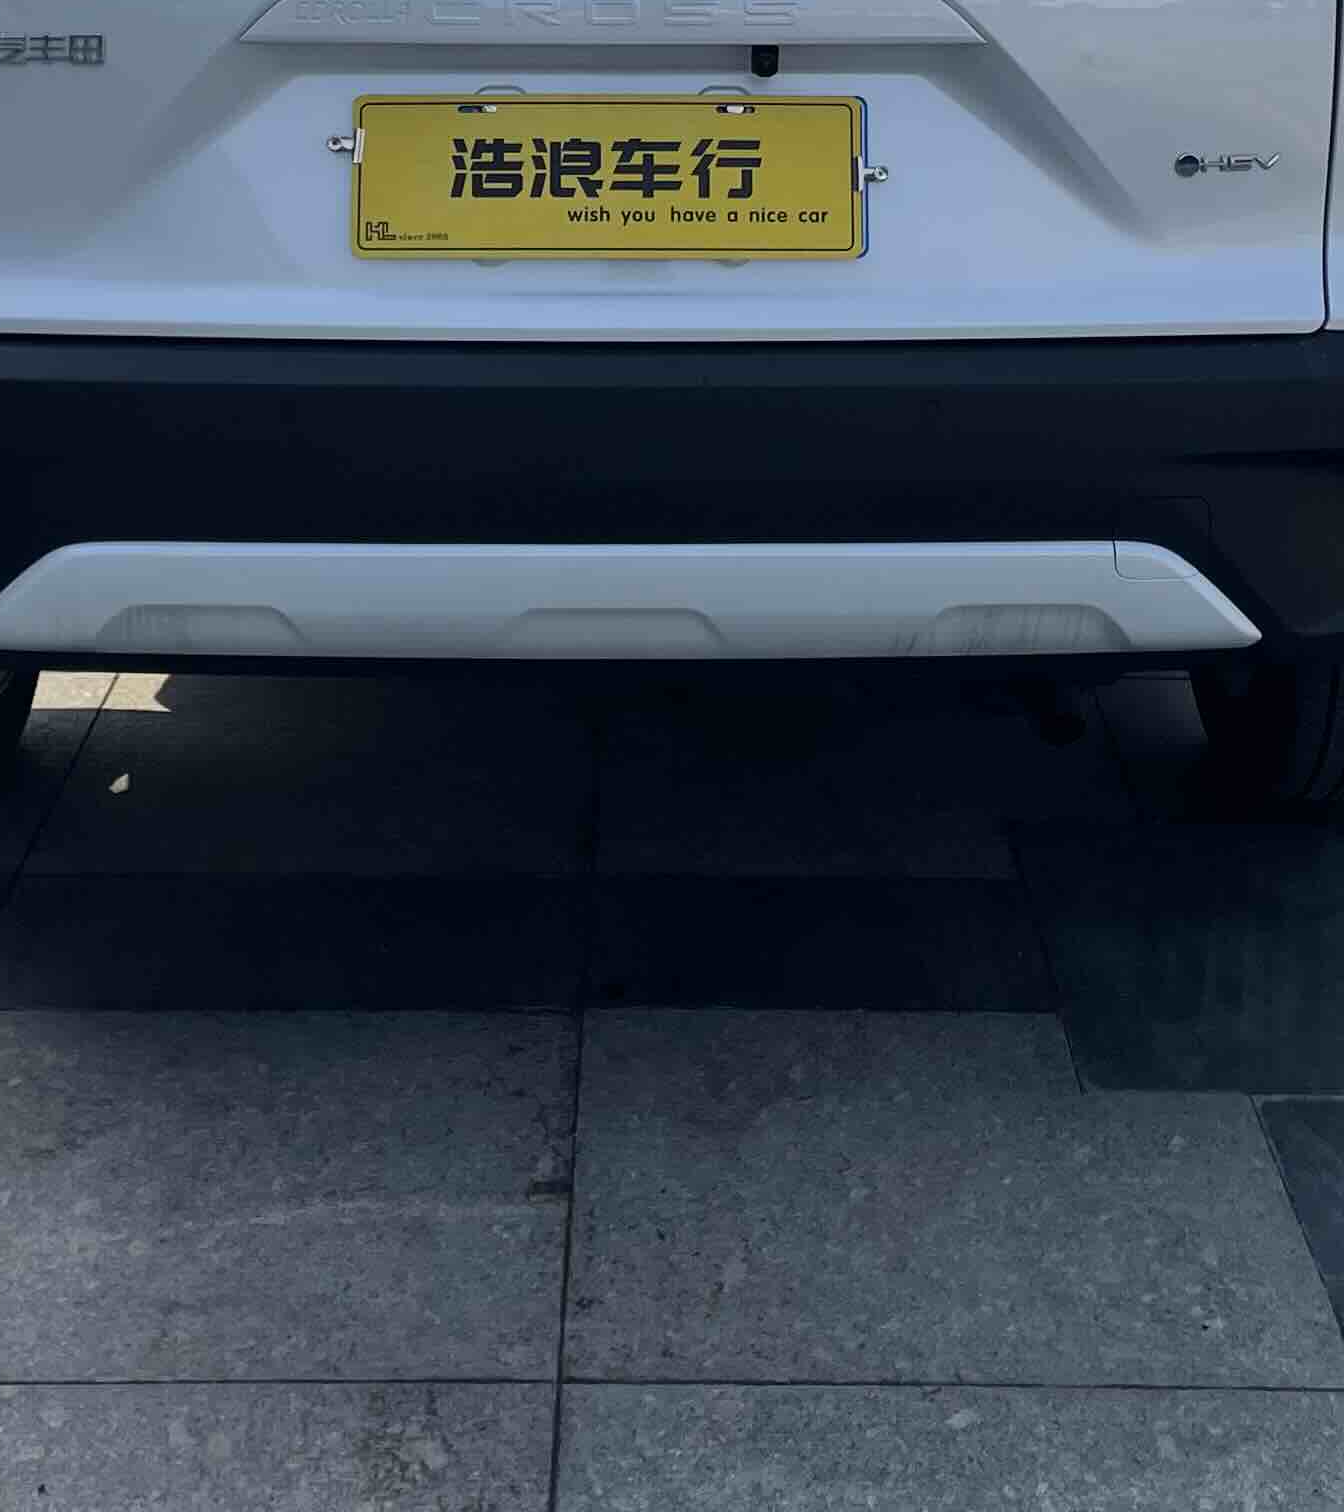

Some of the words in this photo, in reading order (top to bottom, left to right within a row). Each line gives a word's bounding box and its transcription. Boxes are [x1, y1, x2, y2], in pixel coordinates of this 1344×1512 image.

[450, 138, 763, 199] 浩浪车行
[567, 205, 611, 223] wish
[621, 209, 656, 226] you
[670, 205, 717, 223] have
[727, 210, 739, 223] a
[748, 205, 788, 223] nice
[798, 210, 829, 223] car
